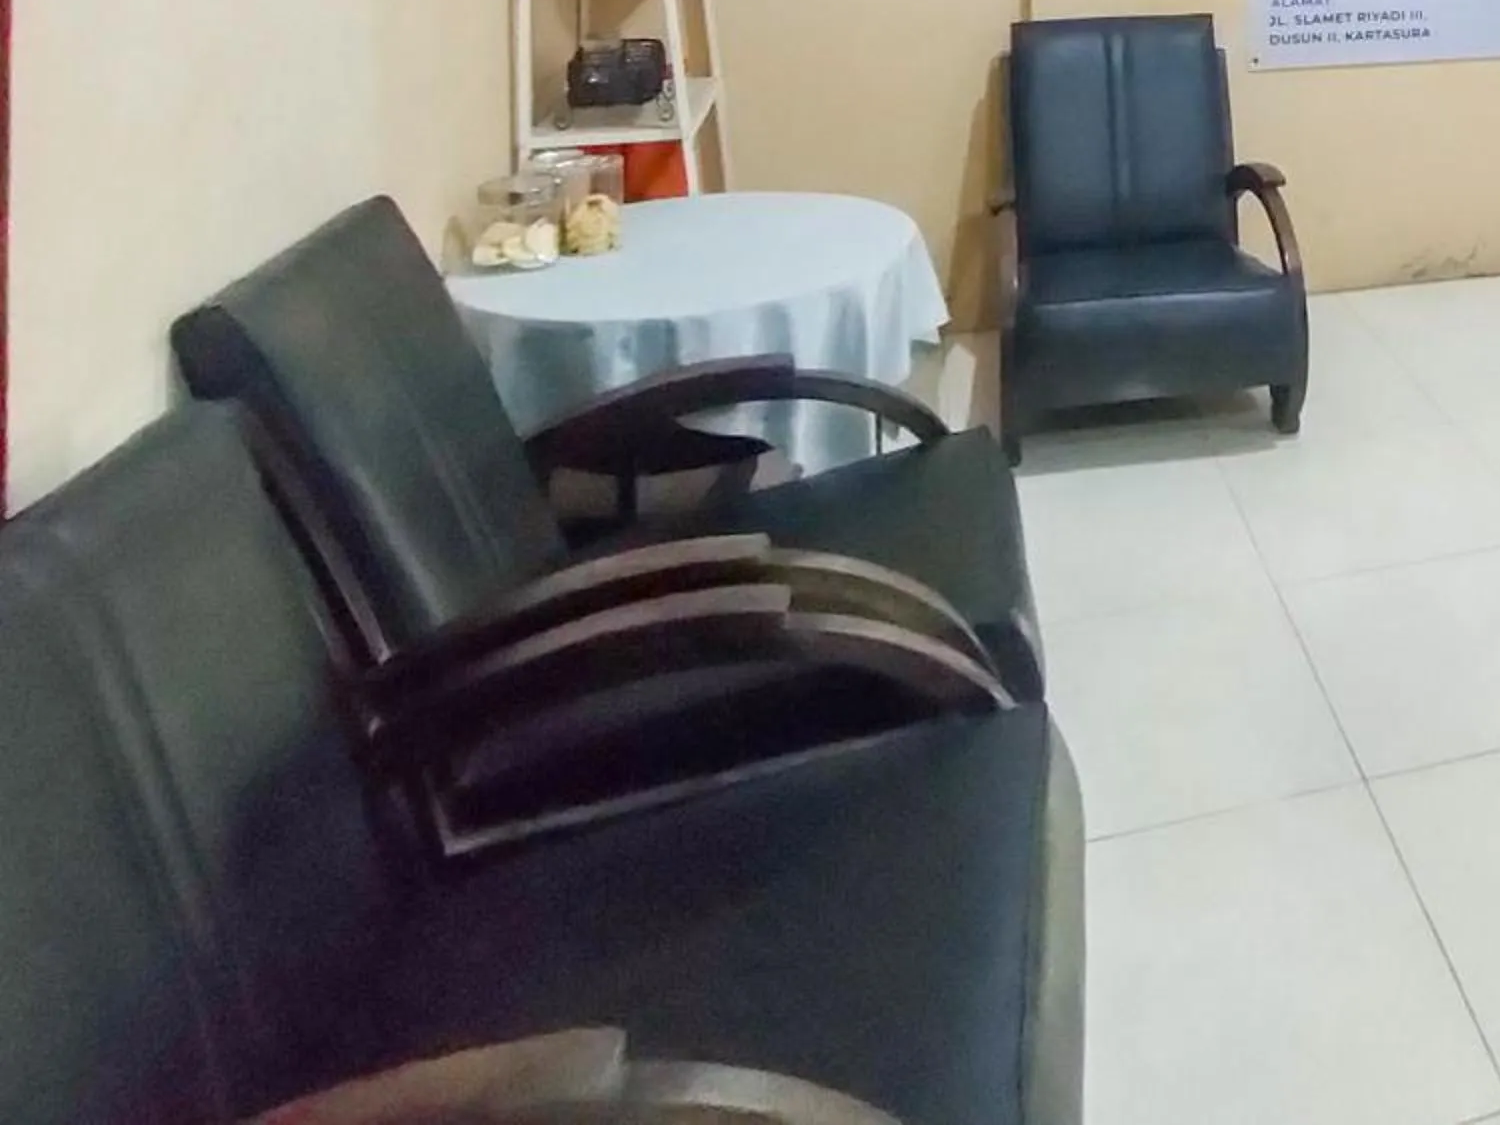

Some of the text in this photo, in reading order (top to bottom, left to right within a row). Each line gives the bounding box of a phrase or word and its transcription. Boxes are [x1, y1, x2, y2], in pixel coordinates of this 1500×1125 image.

[1294, 12, 1353, 26] SLAMET
[1357, 10, 1406, 24] RIYADI
[1269, 33, 1323, 46] DUSUN
[1345, 27, 1431, 42] KARTASURA
